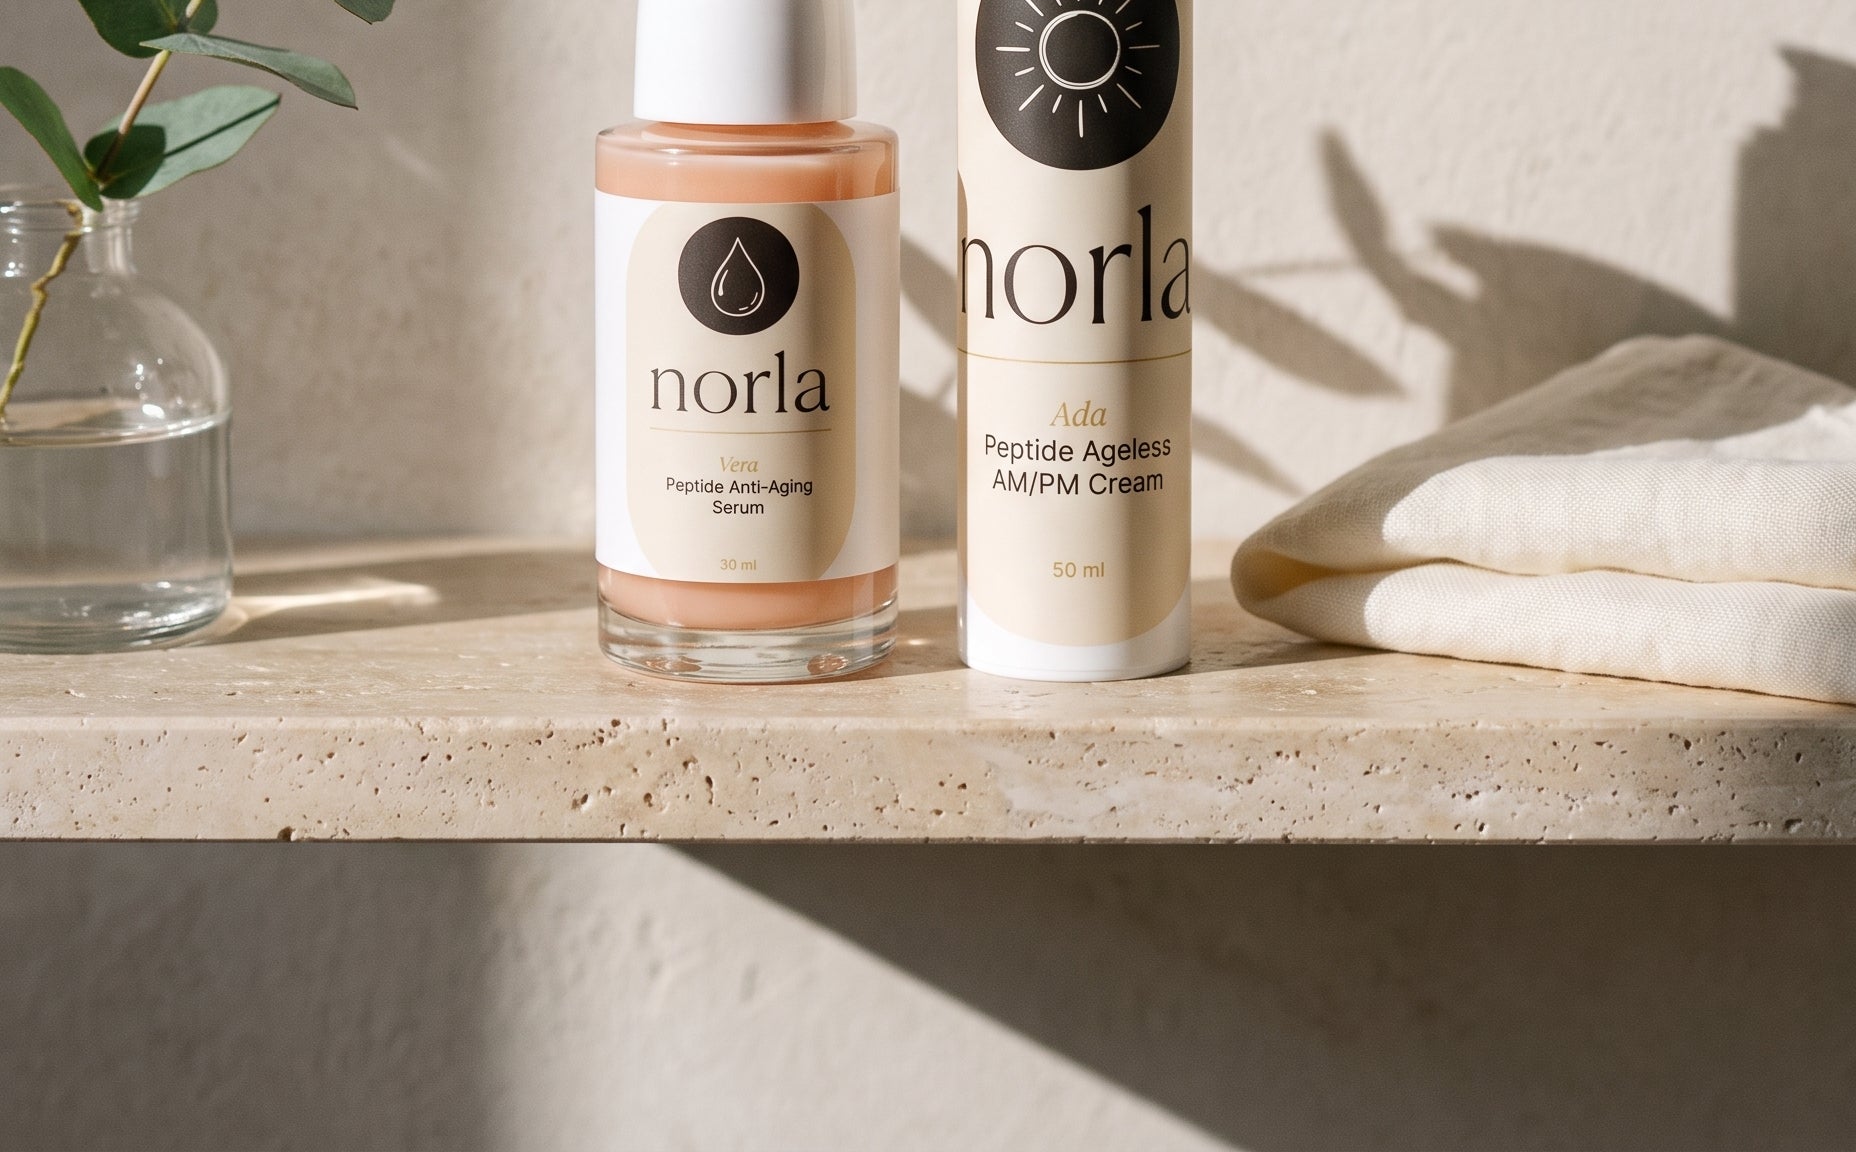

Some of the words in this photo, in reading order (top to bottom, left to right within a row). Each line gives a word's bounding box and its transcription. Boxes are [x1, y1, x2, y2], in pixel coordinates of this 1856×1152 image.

[960, 204, 1191, 325] norla
[651, 350, 830, 414] norla
[1049, 400, 1108, 427] Ada
[984, 434, 1074, 464] Peptide
[1083, 437, 1171, 467] Ageless
[719, 456, 759, 473] Vera
[666, 477, 724, 496] Peptide
[729, 478, 813, 497] Anti-Aging
[992, 469, 1079, 497] AM/PM
[1088, 471, 1164, 496] Cream
[712, 500, 765, 515] Serum
[720, 559, 737, 571] 30
[740, 558, 757, 571] ml
[1052, 562, 1077, 578] 50
[1083, 561, 1105, 578] ml
